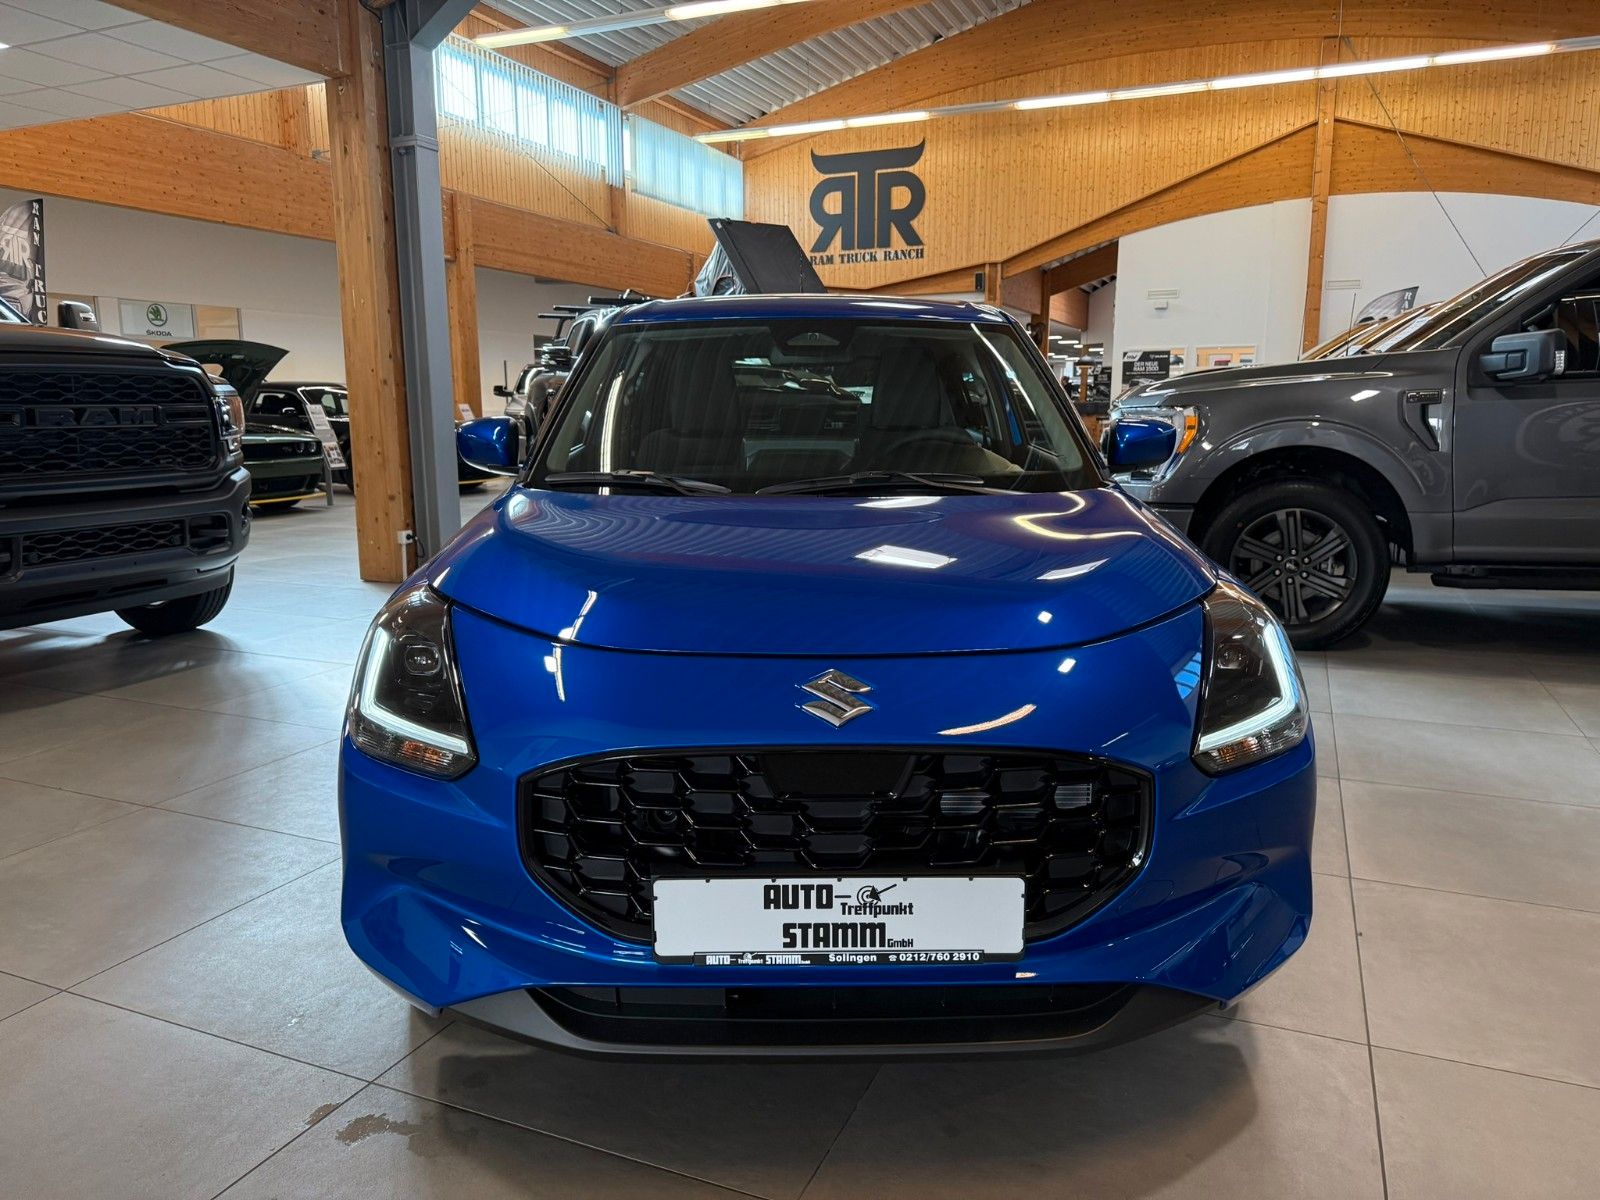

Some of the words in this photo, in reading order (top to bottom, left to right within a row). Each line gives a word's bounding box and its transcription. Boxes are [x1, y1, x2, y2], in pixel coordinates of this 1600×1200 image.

[809, 255, 834, 266] RAM
[839, 251, 878, 264] TRUCK
[883, 248, 925, 260] RANCH
[35, 263, 47, 326] TRUC
[34, 407, 155, 427] RAM
[840, 902, 914, 918] Treffpunkt
[782, 922, 887, 949] STAMM
[887, 938, 914, 948] GmbH
[765, 954, 802, 965] STAMM
[828, 953, 877, 963] Solingen
[899, 953, 950, 962] 0212/760
[952, 952, 980, 961] 2910
